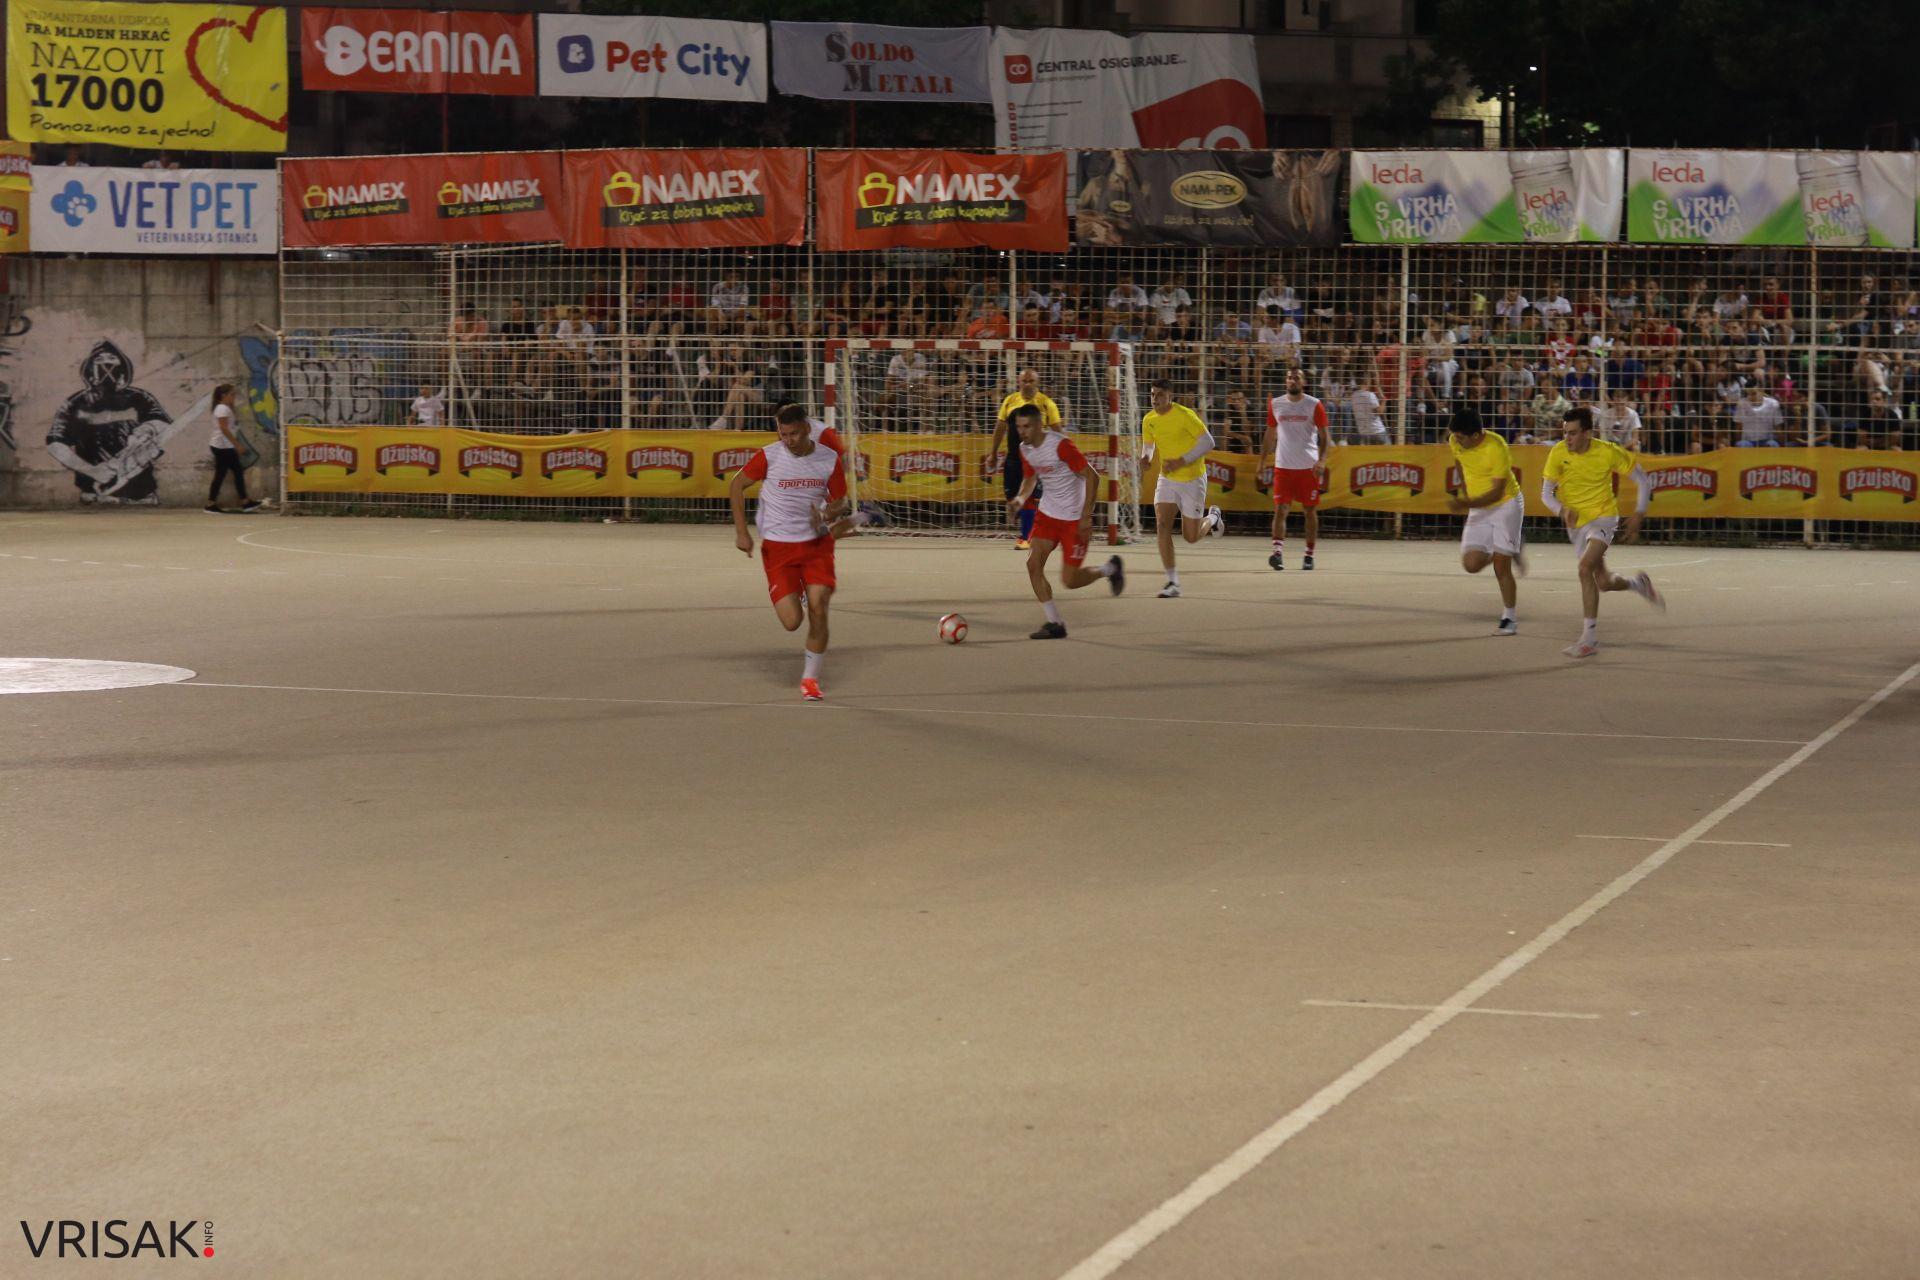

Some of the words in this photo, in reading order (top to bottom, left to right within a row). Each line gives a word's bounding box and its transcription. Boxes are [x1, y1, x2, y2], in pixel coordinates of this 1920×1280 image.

[25, 23, 51, 35] FRA
[55, 26, 115, 40] MLADEN
[30, 41, 164, 74] NAZOVI
[314, 25, 521, 76] BERNINA
[606, 40, 668, 73] Pet
[676, 43, 750, 87] City
[1036, 59, 1096, 74] CENTRAL
[31, 73, 164, 113] 17000
[30, 113, 131, 135] Pomozimo
[137, 121, 216, 144] zajedno!
[1372, 163, 1424, 184] leda
[1652, 161, 1705, 183] leda
[327, 181, 406, 206] NAMEX
[462, 178, 541, 203] NAMEX
[642, 168, 761, 205] NAMEX
[896, 173, 1021, 205] NAMEX
[108, 180, 181, 229] VET
[190, 182, 258, 229] PET
[1399, 194, 1459, 219] VRHA
[1522, 187, 1569, 210] leda
[1676, 194, 1740, 219] VRHA
[1808, 190, 1856, 212] leda
[136, 232, 214, 244] VETERINARSKA
[216, 232, 258, 244] STANICA
[1376, 214, 1464, 241] VRHOVA
[1653, 215, 1744, 240] VRHOVA
[301, 444, 353, 465] Ožujsko
[381, 444, 436, 466] Ožujsko
[464, 446, 518, 468] Ožujsko
[547, 448, 603, 469] Ožujsko
[631, 447, 689, 469] Ožujsko
[1356, 464, 1419, 486] Ožujsko
[1746, 466, 1811, 489] Ožujsko
[1846, 469, 1912, 491] Ožujsko
